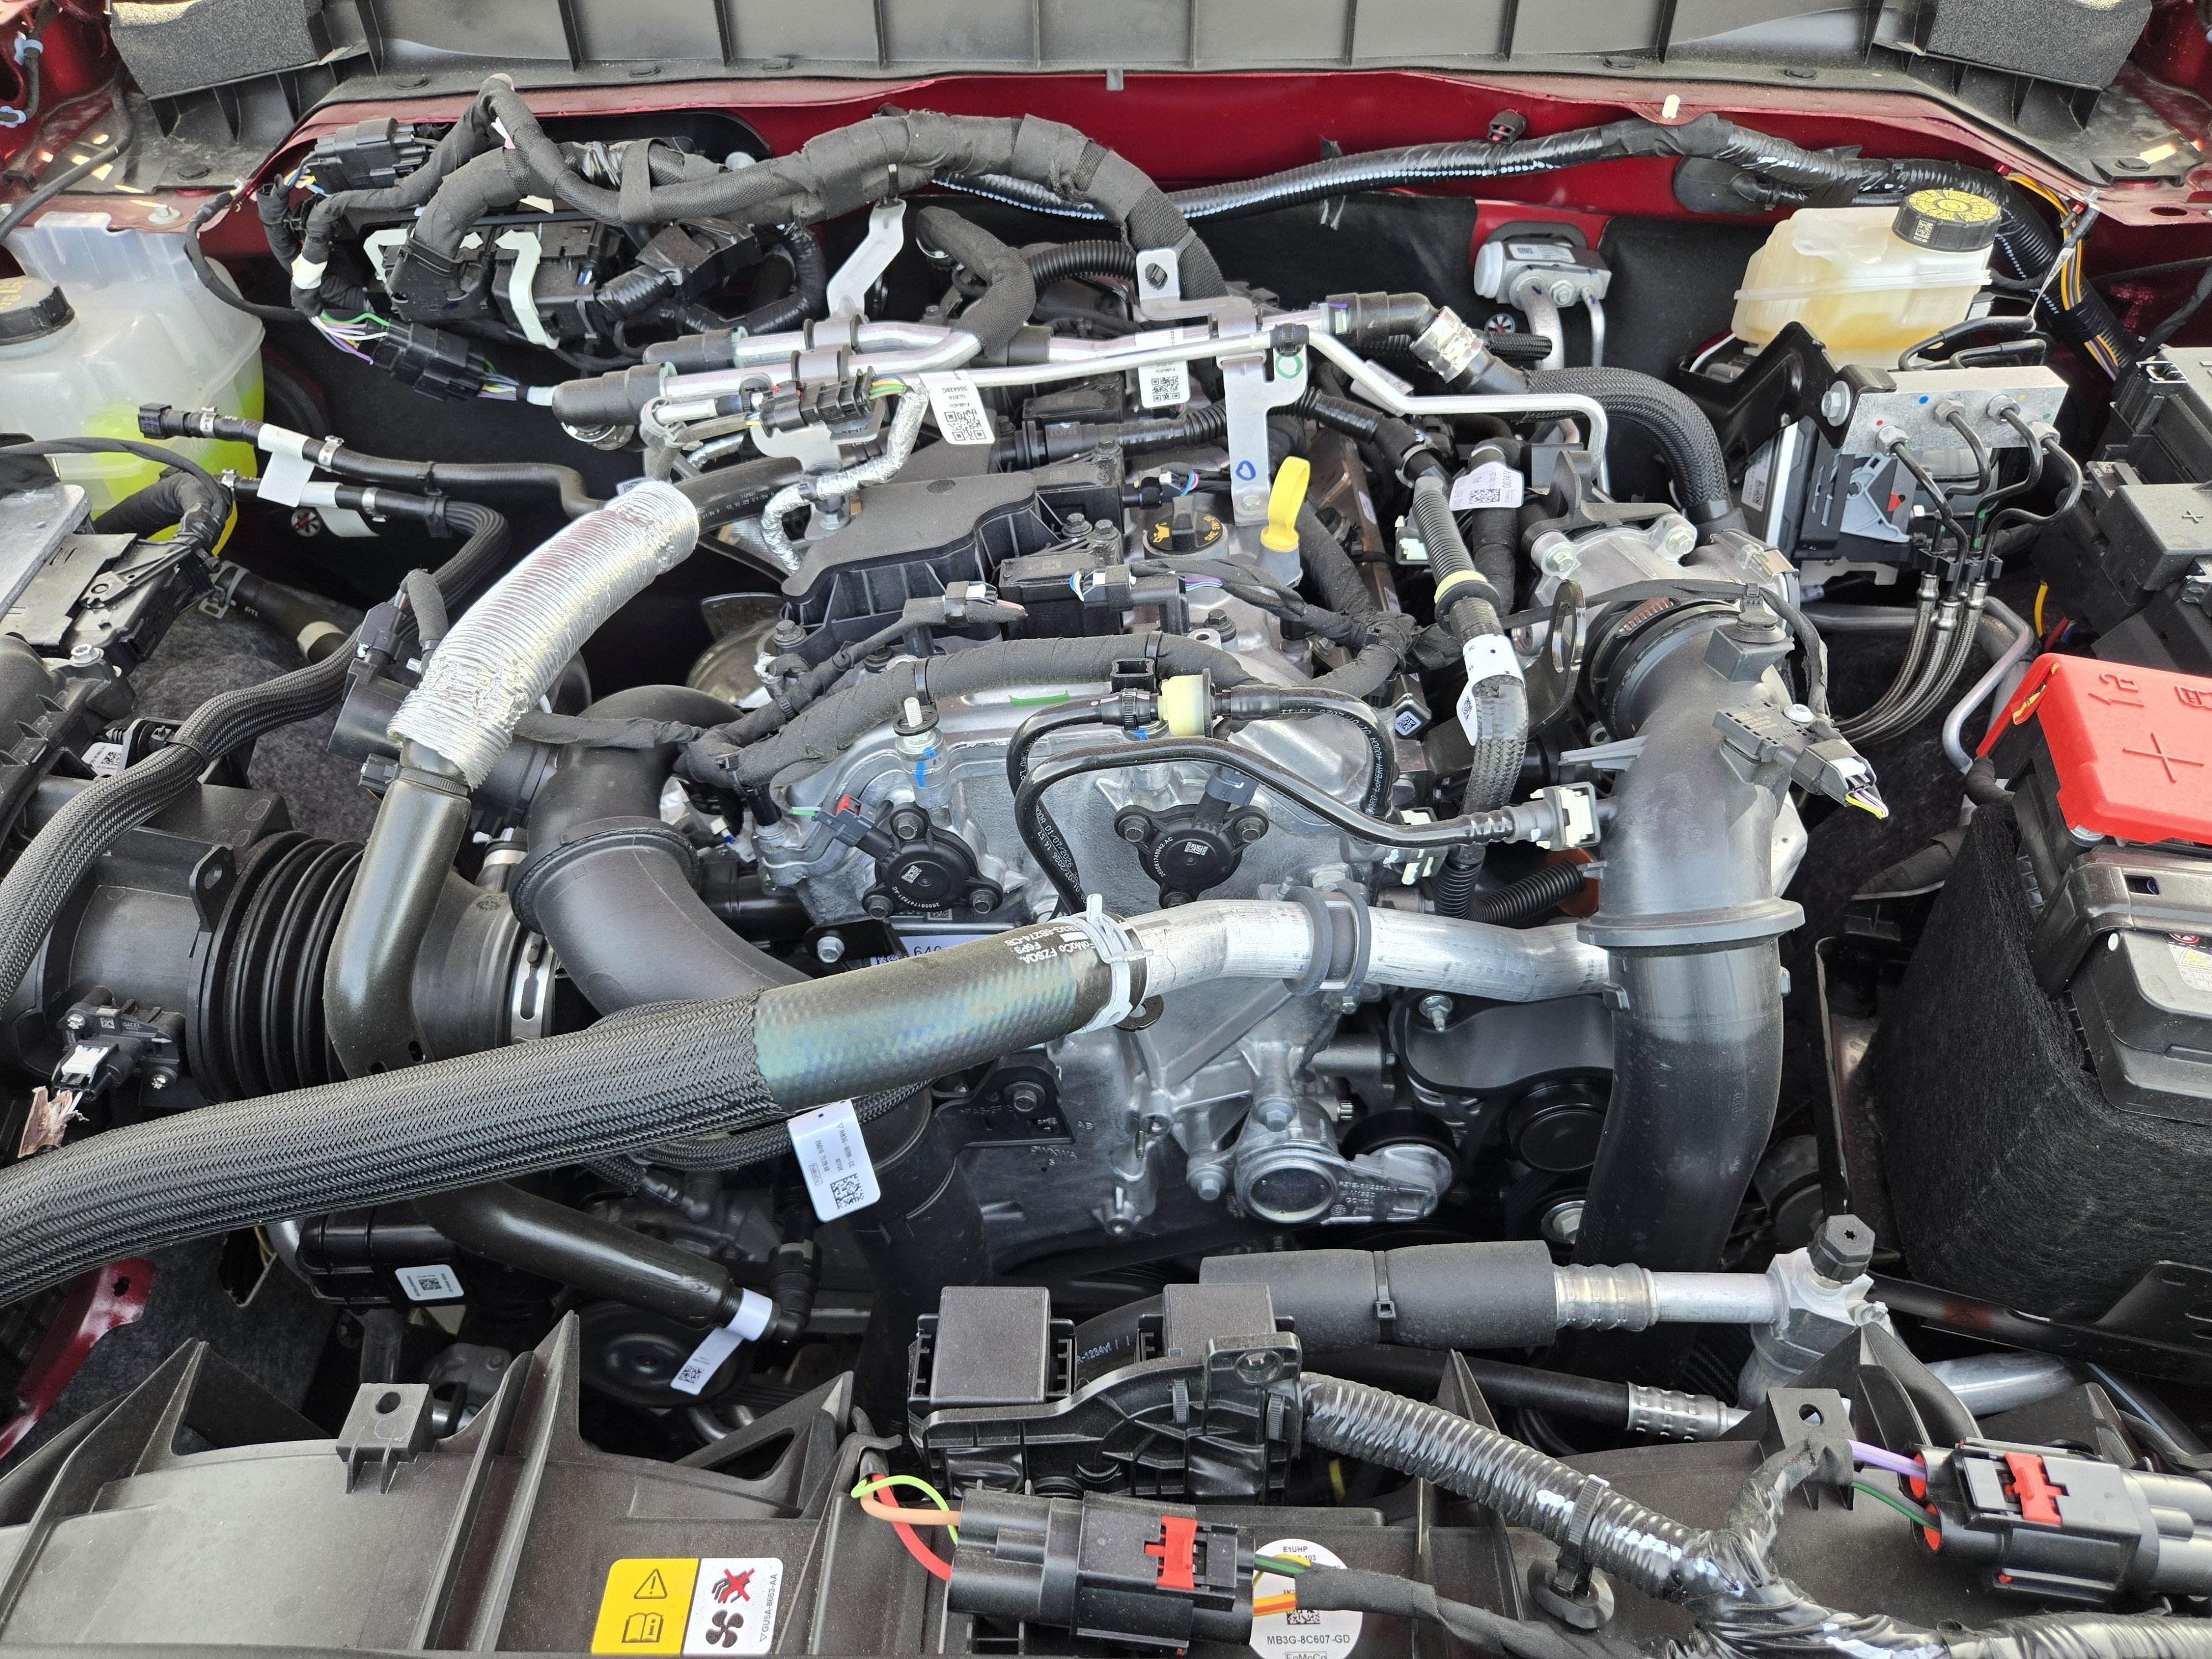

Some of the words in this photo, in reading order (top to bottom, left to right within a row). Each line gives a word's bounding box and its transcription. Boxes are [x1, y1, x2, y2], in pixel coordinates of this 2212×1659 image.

[1203, 515, 1220, 530] 5W-30
[1204, 531, 1219, 541] SAE
[1044, 825, 1073, 868] 01/07/2026
[810, 1164, 820, 1184] FoMoCo
[761, 1573, 778, 1632] GU5A-8653-AA
[1266, 1634, 1350, 1645] MB3G-8C607-GD
